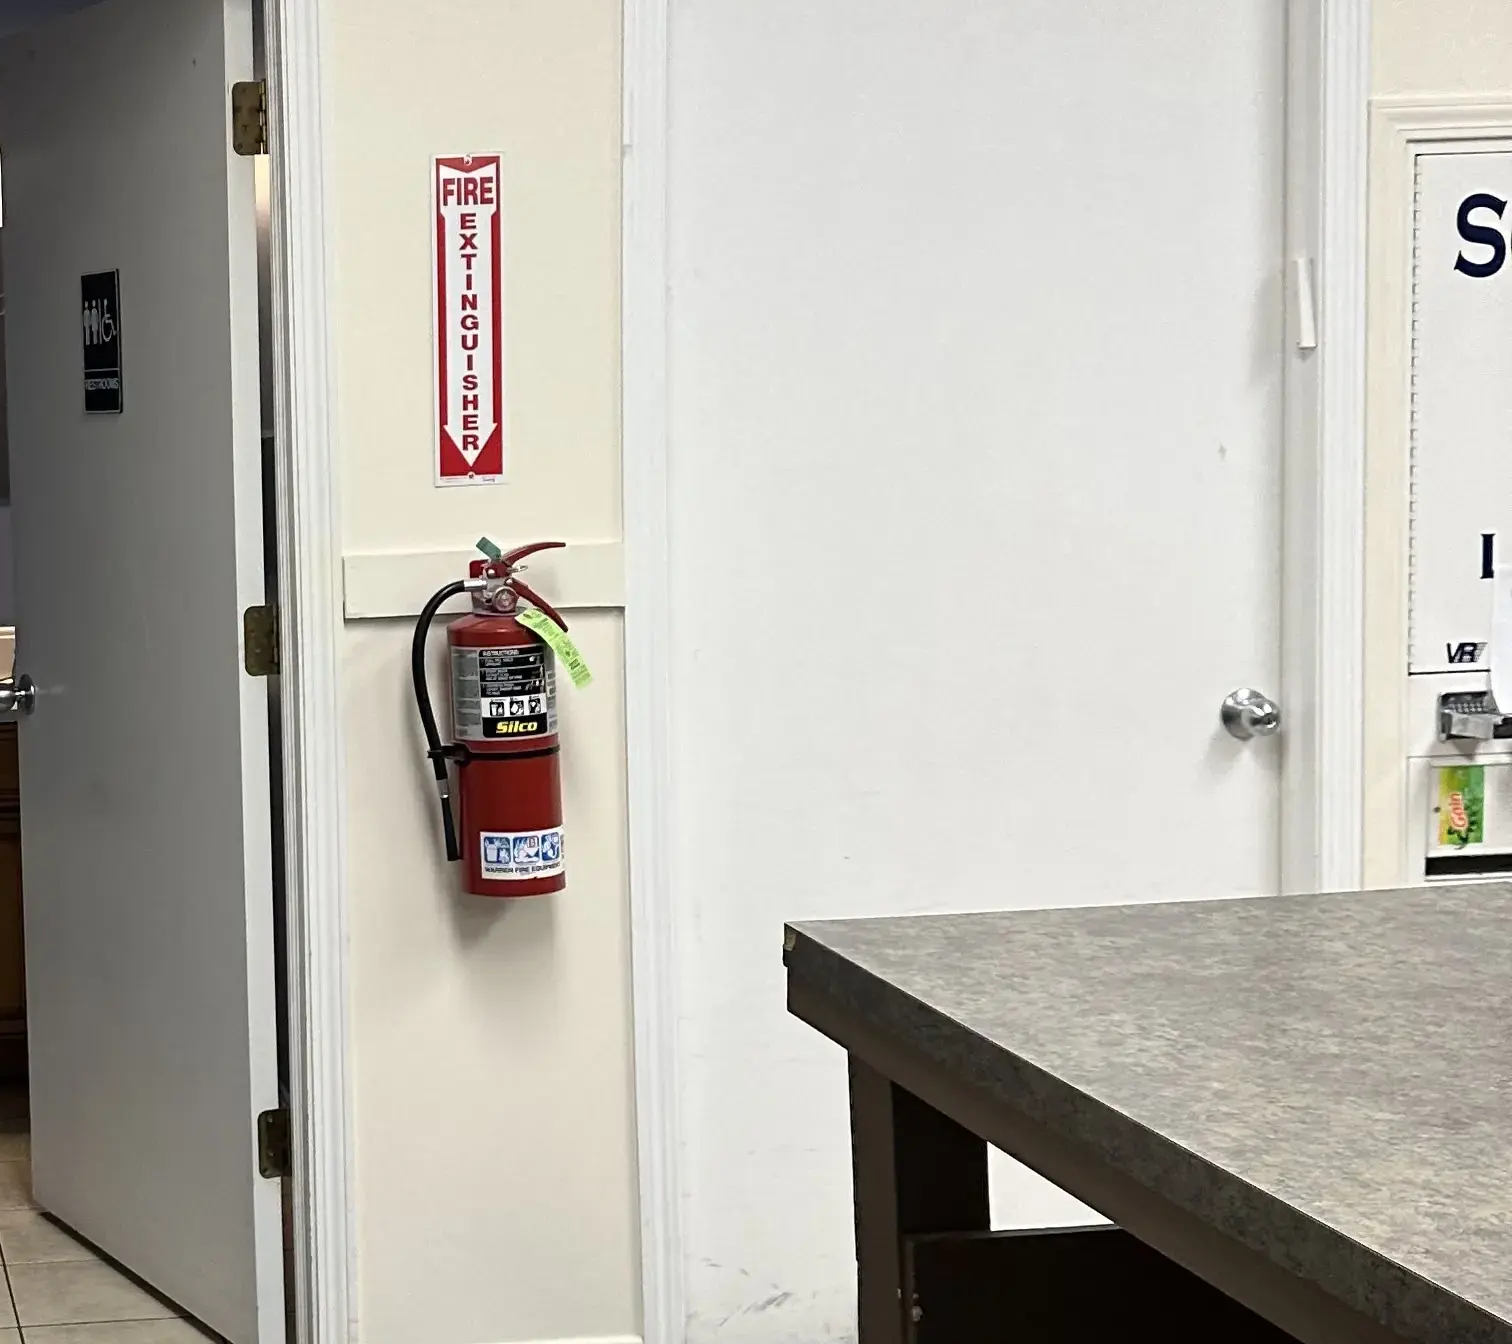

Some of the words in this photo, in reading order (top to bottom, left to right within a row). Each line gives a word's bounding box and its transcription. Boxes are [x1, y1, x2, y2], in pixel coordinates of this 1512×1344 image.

[442, 176, 494, 206] FIRE
[1454, 193, 1512, 278] S
[459, 212, 480, 451] EXTINGUISHER
[496, 720, 538, 733] Silco
